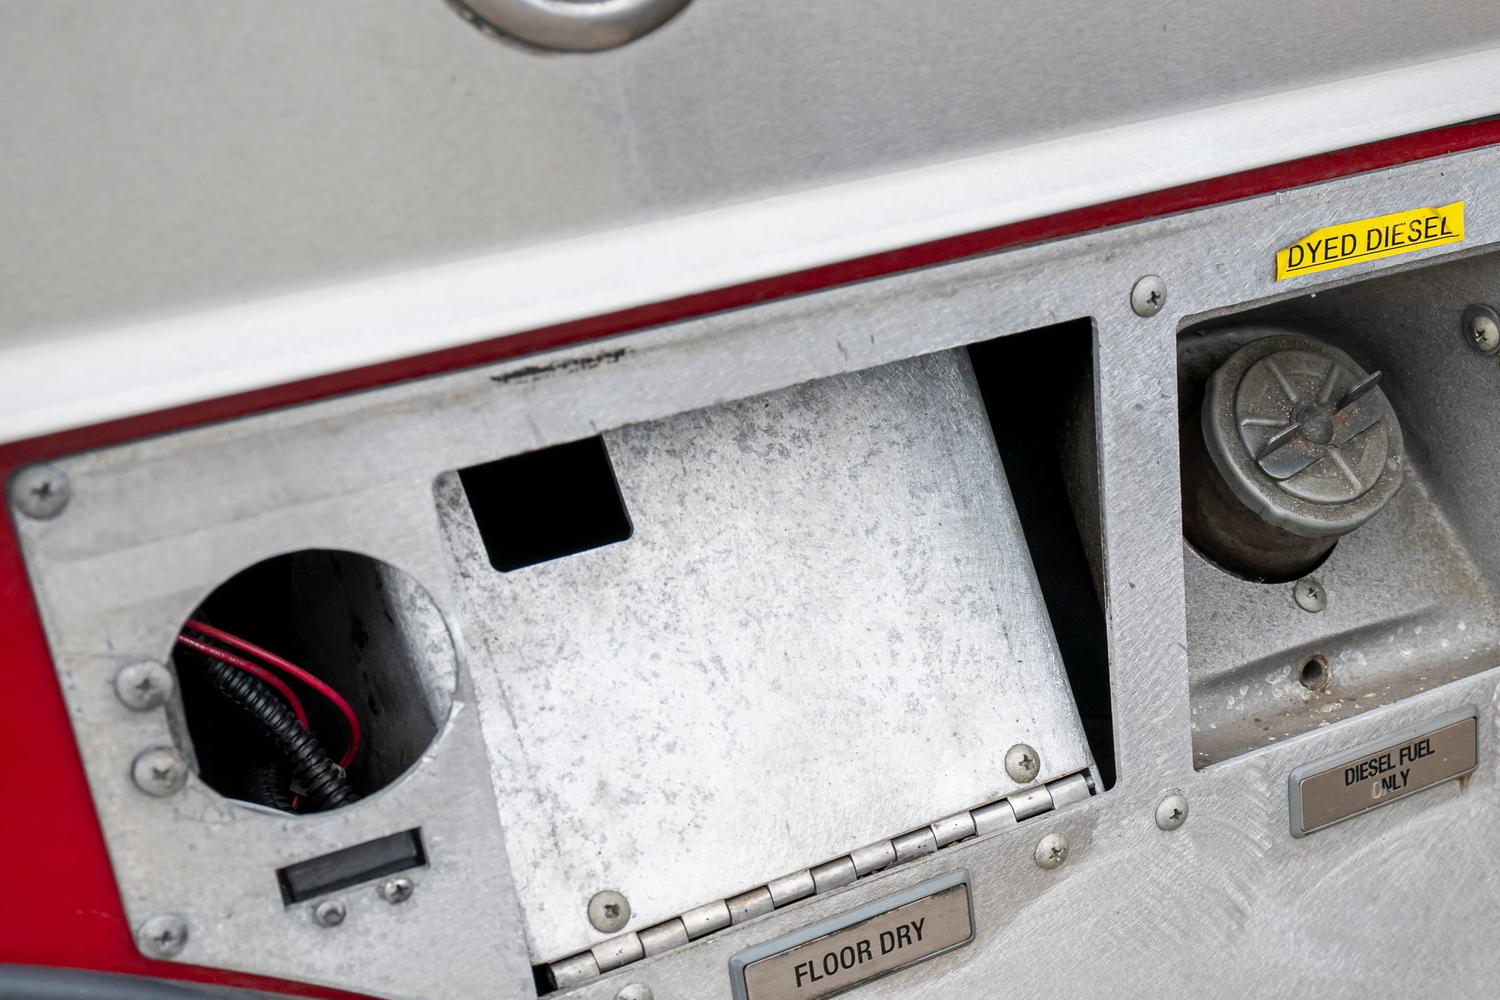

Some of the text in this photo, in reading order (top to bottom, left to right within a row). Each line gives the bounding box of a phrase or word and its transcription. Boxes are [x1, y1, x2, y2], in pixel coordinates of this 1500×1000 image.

[1288, 215, 1453, 268] DYED DIESEL
[1344, 738, 1435, 787] DIESEL FUEL
[794, 917, 926, 988] FLOOR DRY
